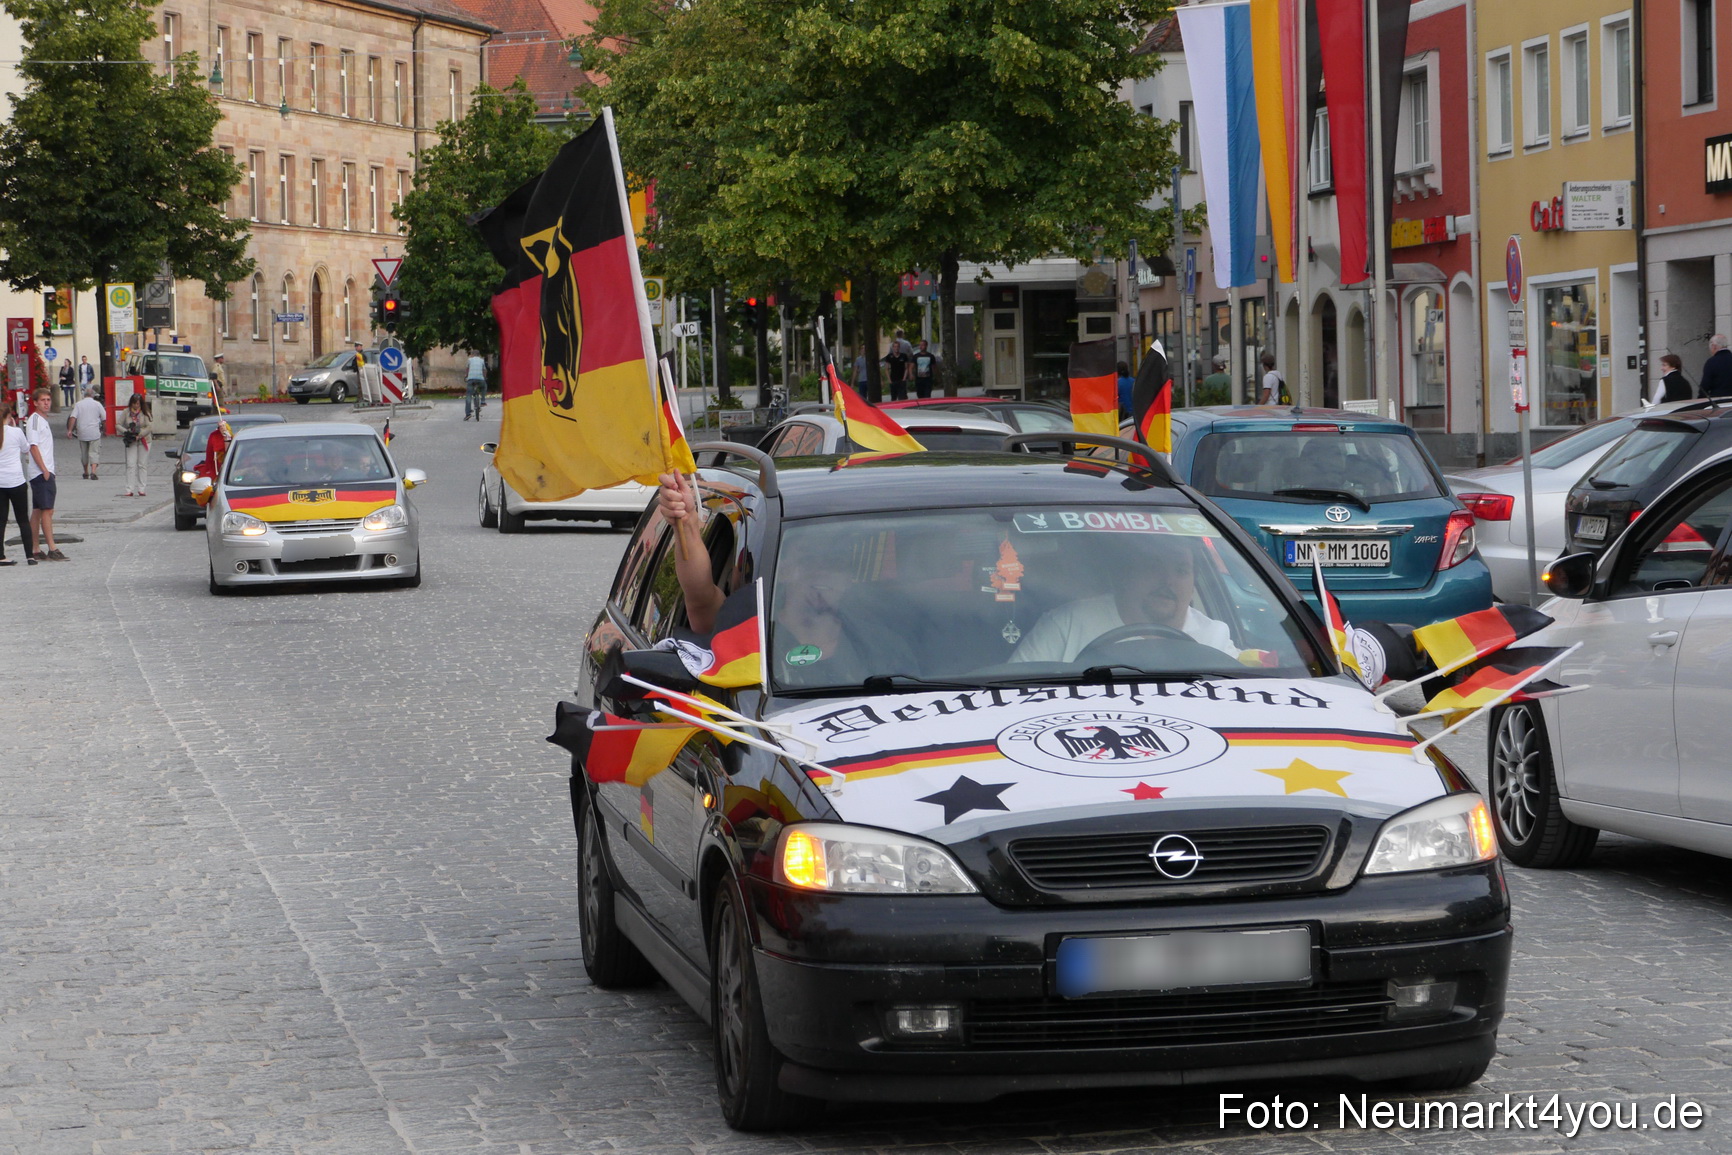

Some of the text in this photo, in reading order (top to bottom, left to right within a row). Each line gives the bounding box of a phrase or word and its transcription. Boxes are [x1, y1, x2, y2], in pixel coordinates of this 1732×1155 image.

[1706, 140, 1732, 183] MA
[115, 291, 125, 303] H
[680, 323, 696, 335] WC
[158, 380, 198, 390] POLIZEI
[1059, 511, 1174, 532] BOMBA
[1414, 535, 1438, 544] YARIS
[1328, 543, 1347, 560] MM
[1351, 543, 1389, 560] 1006
[800, 645, 809, 655] 4
[1009, 713, 1194, 741] DEUTSCHLAND
